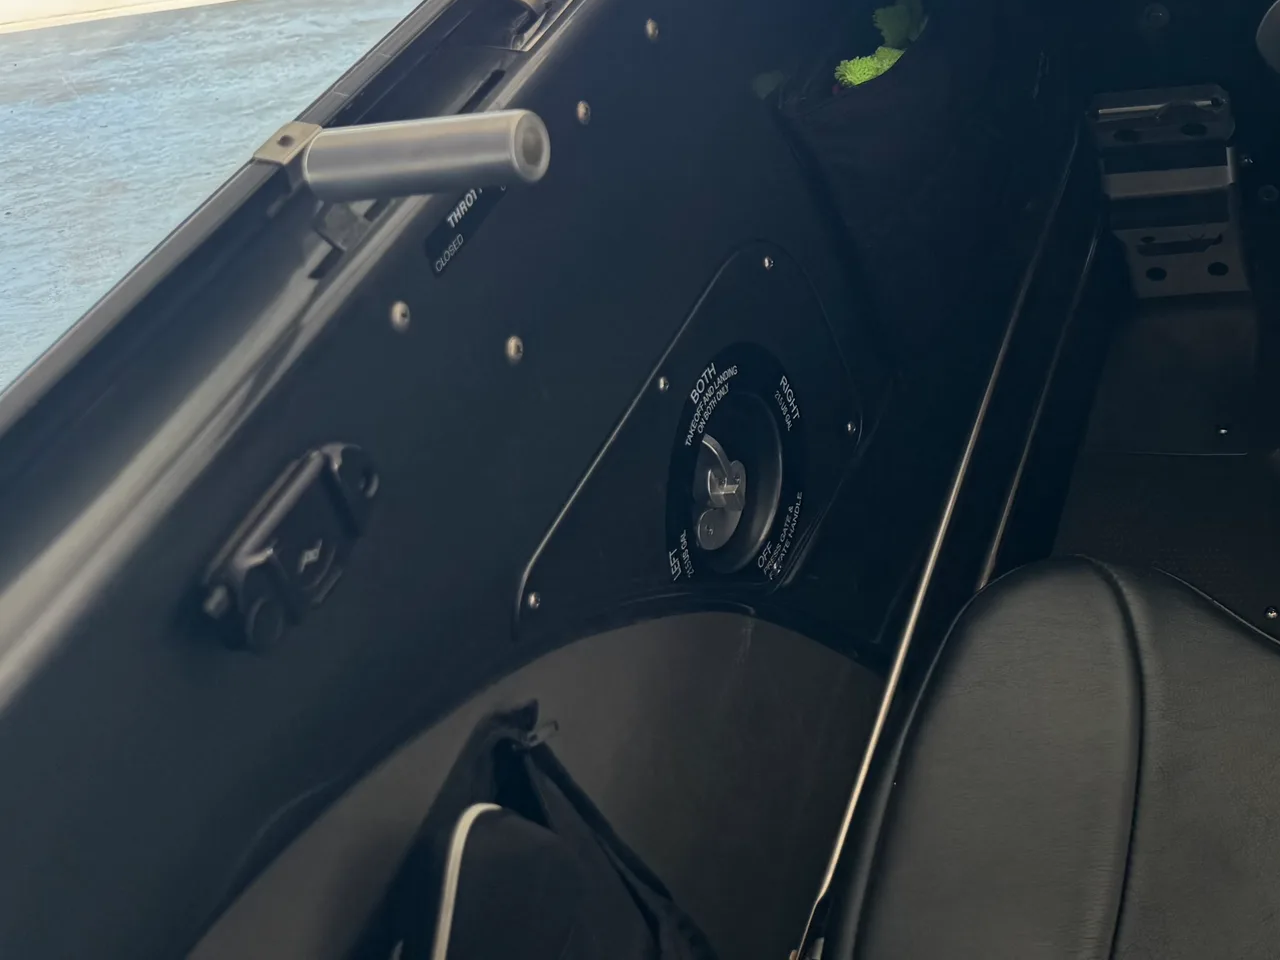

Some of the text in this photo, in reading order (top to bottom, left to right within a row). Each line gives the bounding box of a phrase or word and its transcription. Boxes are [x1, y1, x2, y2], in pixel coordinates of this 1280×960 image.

[435, 234, 464, 272] CLOSED
[690, 362, 716, 404] BOTH
[780, 375, 800, 419] RIGHT
[685, 365, 738, 446] TAKEOFF AND LANDING
[698, 383, 729, 433] ON BOTH ONLY
[788, 492, 802, 538] HANDLE
[669, 549, 682, 581] LEFT
[758, 541, 772, 568] OFF
[764, 543, 781, 575] PRESS
[780, 515, 792, 542] GATE
